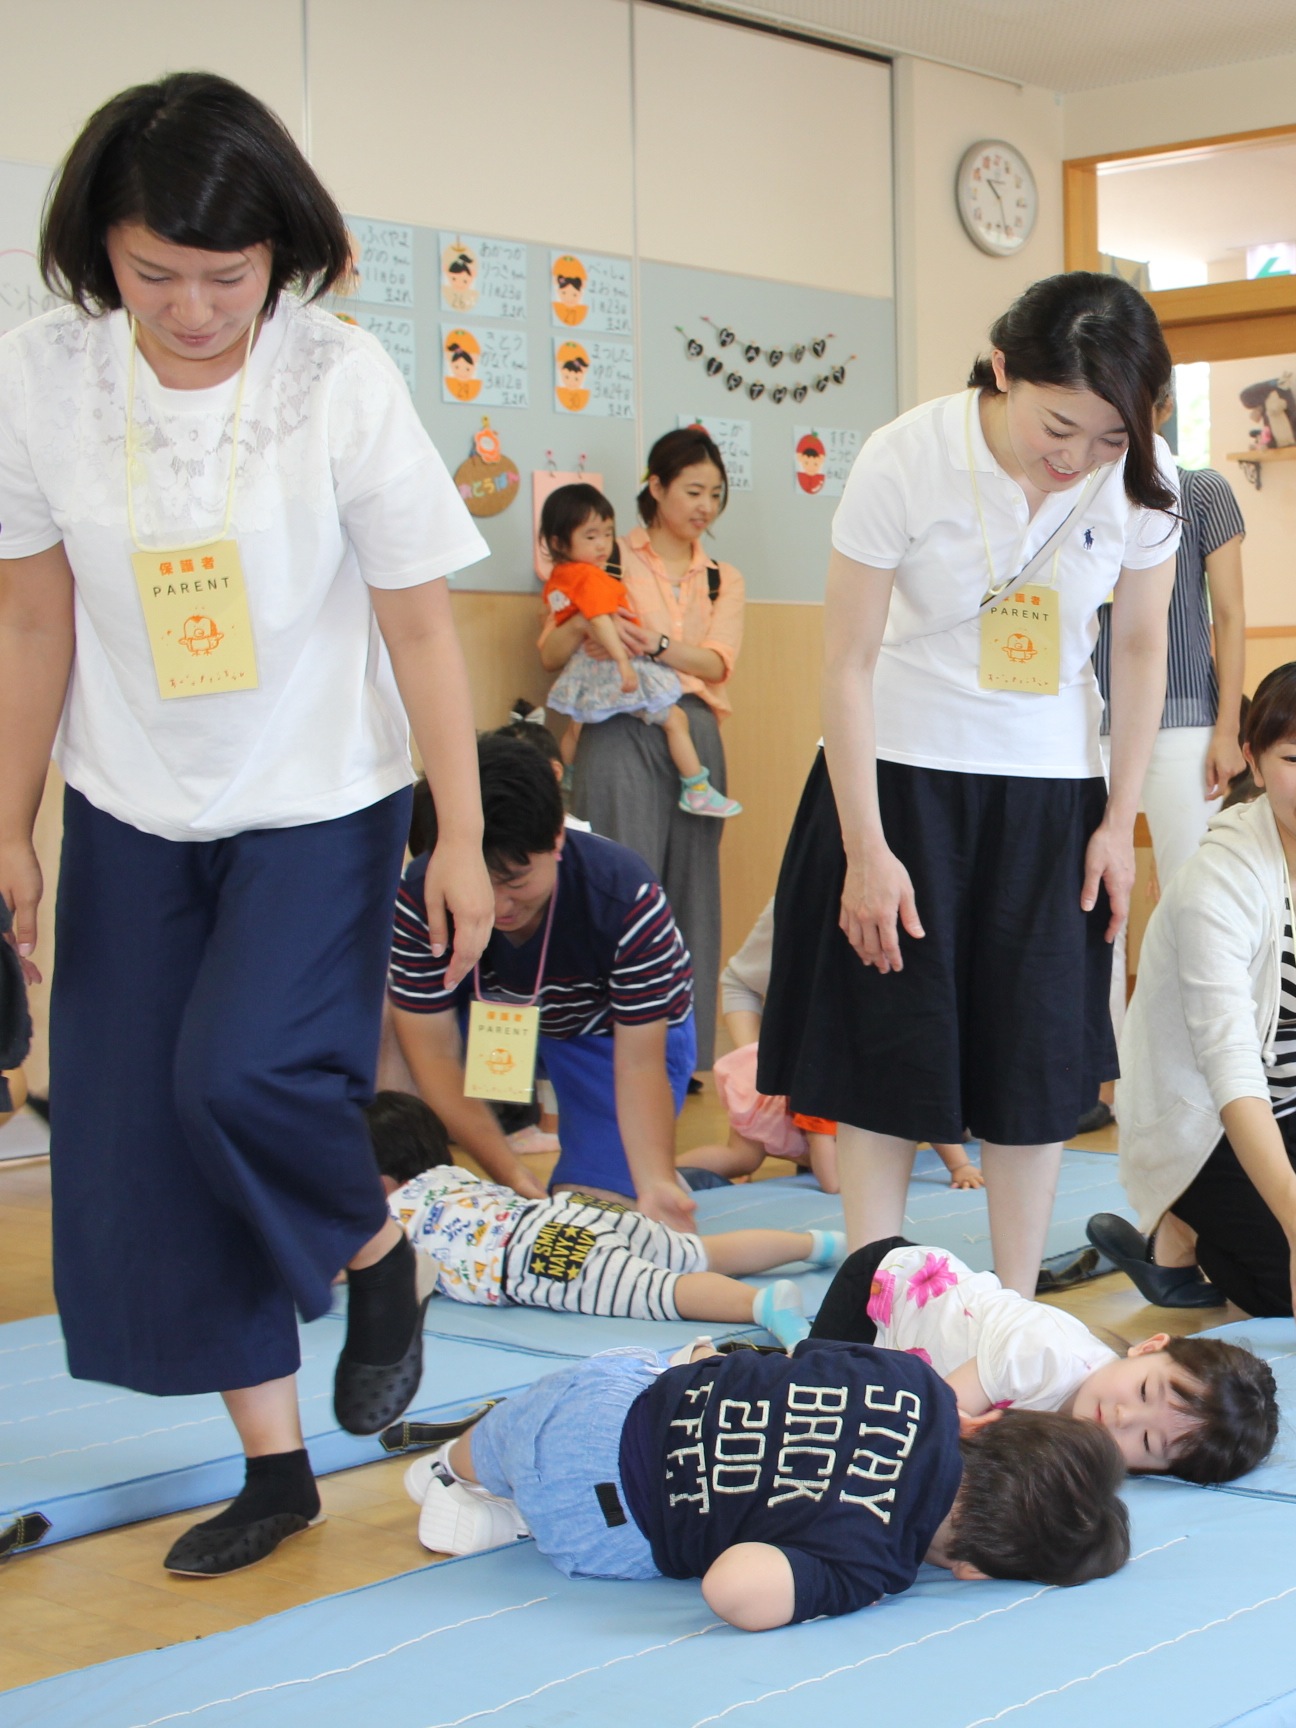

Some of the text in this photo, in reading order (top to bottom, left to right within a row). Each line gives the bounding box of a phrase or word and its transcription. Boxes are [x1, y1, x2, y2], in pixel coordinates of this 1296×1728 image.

[153, 577, 231, 597] PARENT
[990, 607, 1049, 622] PARENT
[478, 1024, 529, 1036] PARENT
[533, 1221, 564, 1257] SMIL
[547, 1236, 575, 1278] NAVY
[711, 1398, 770, 1494] 200
[767, 1382, 849, 1508] BACK
[839, 1384, 922, 1525] STAY
